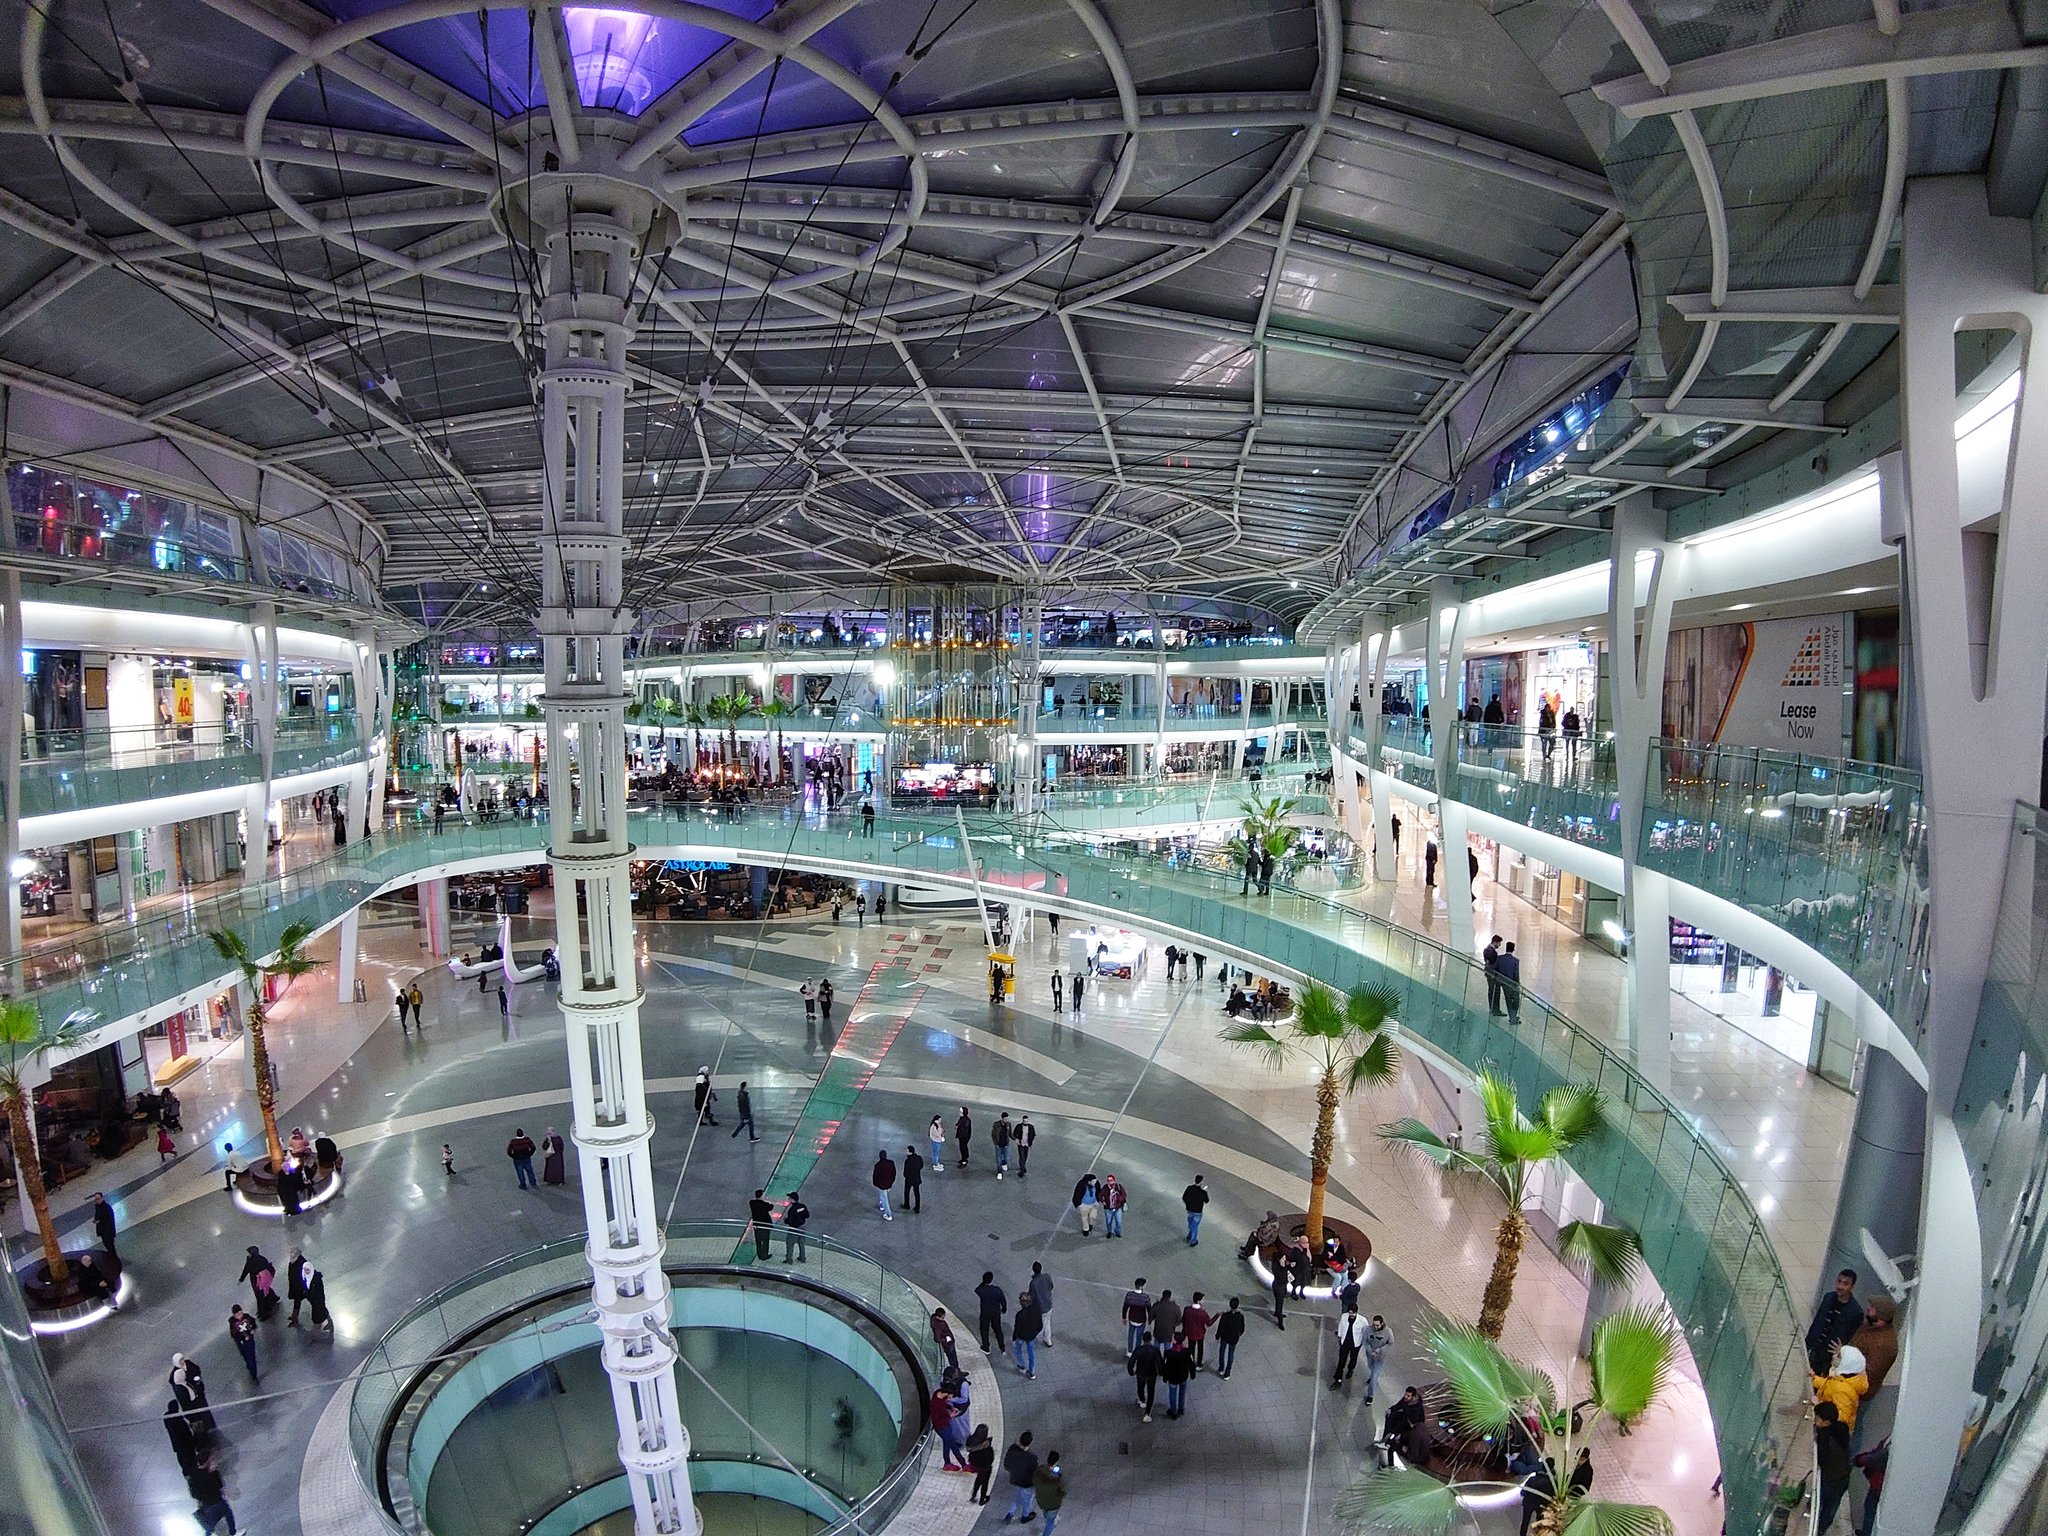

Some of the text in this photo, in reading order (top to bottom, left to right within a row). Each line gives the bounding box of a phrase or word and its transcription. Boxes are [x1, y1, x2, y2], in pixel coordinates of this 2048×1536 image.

[1780, 700, 1817, 719] Lease
[1788, 721, 1815, 739] Now
[666, 860, 731, 871] ASTROLABE
